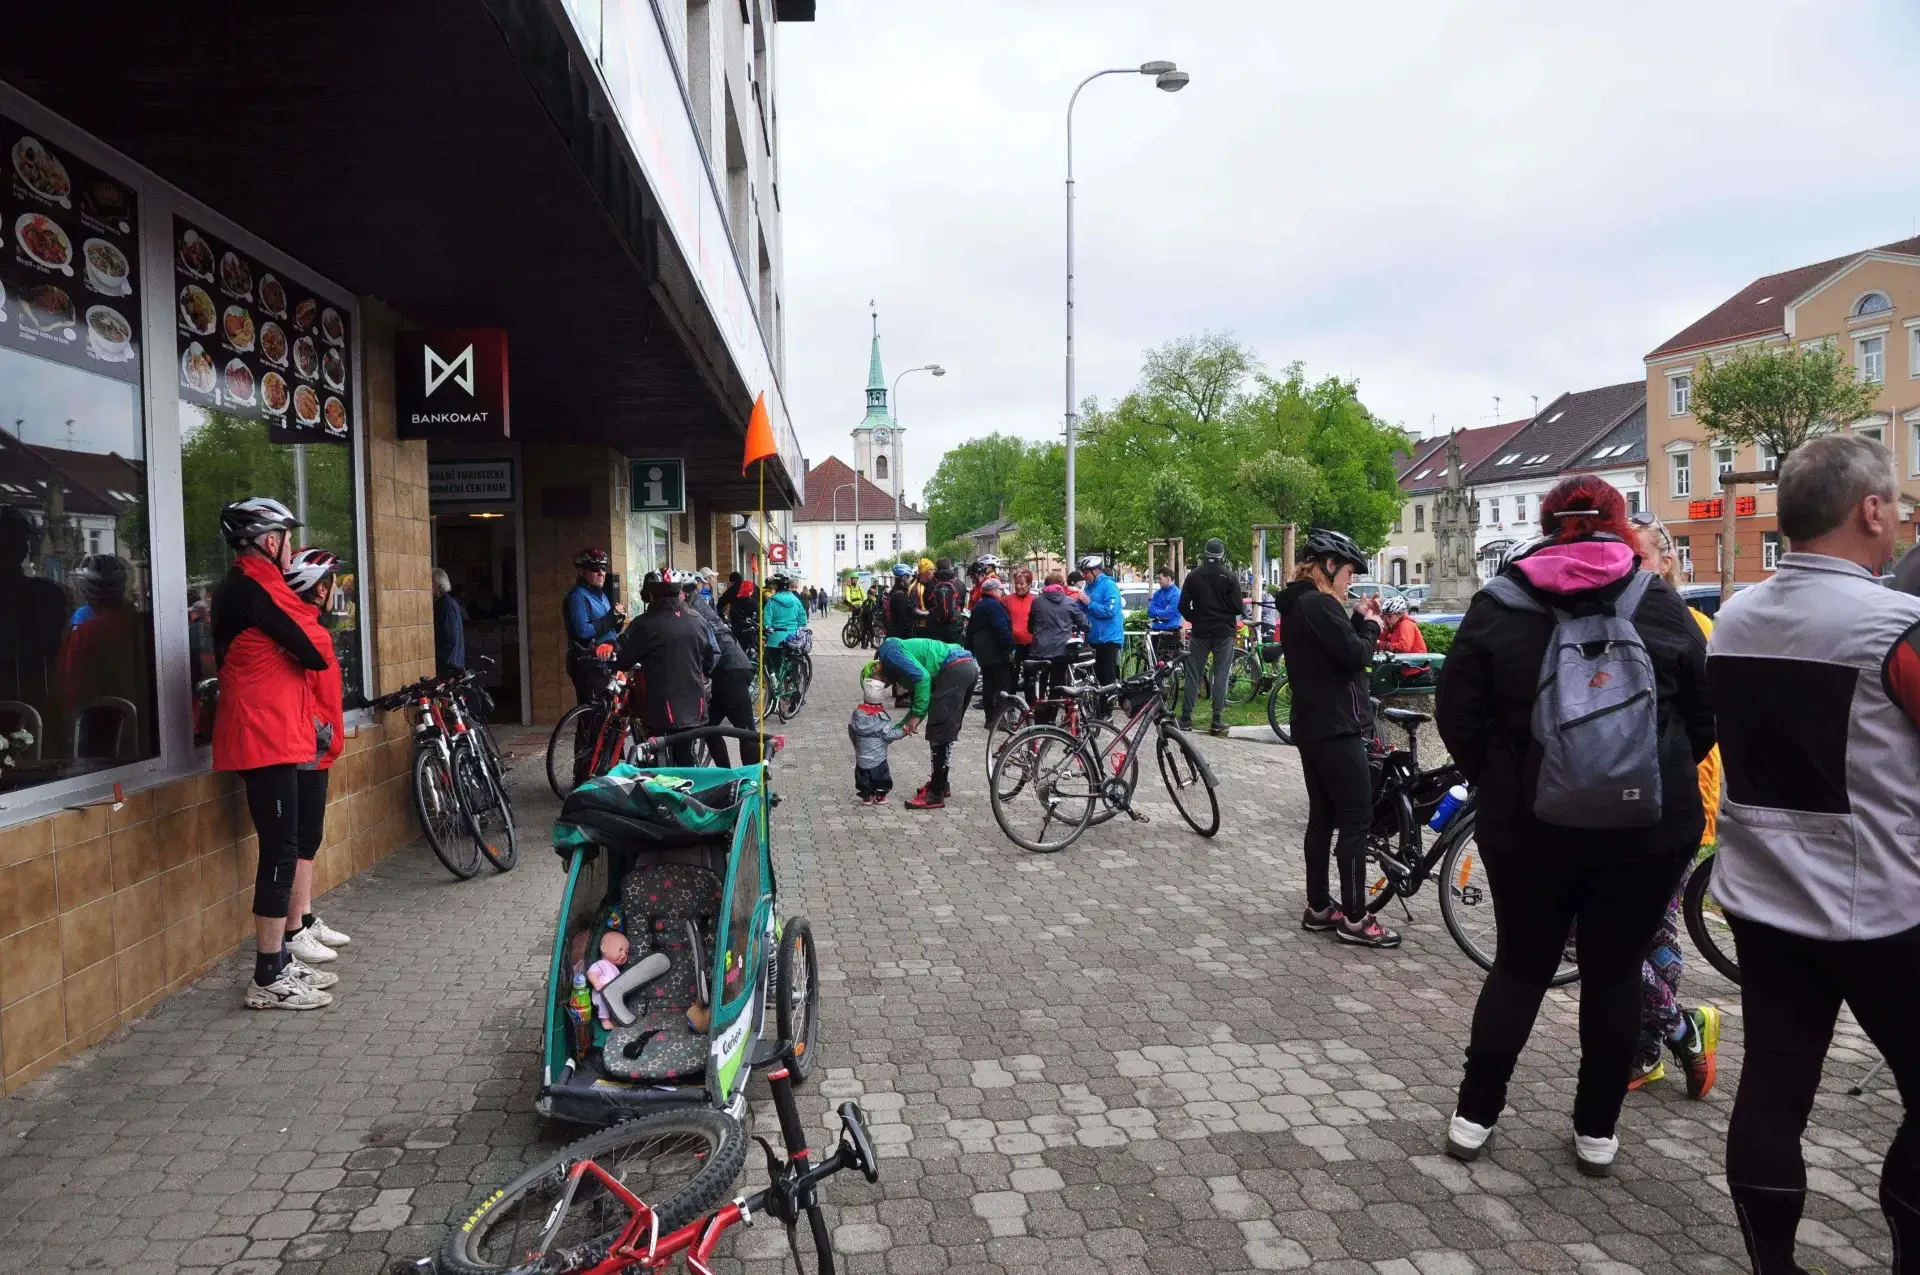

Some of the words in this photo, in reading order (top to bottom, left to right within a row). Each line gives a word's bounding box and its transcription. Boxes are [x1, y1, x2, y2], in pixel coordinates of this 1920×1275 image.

[411, 412, 489, 424] BANKOMAT
[466, 483, 507, 493] CENTRUM
[462, 1189, 504, 1233] MAXXIS
